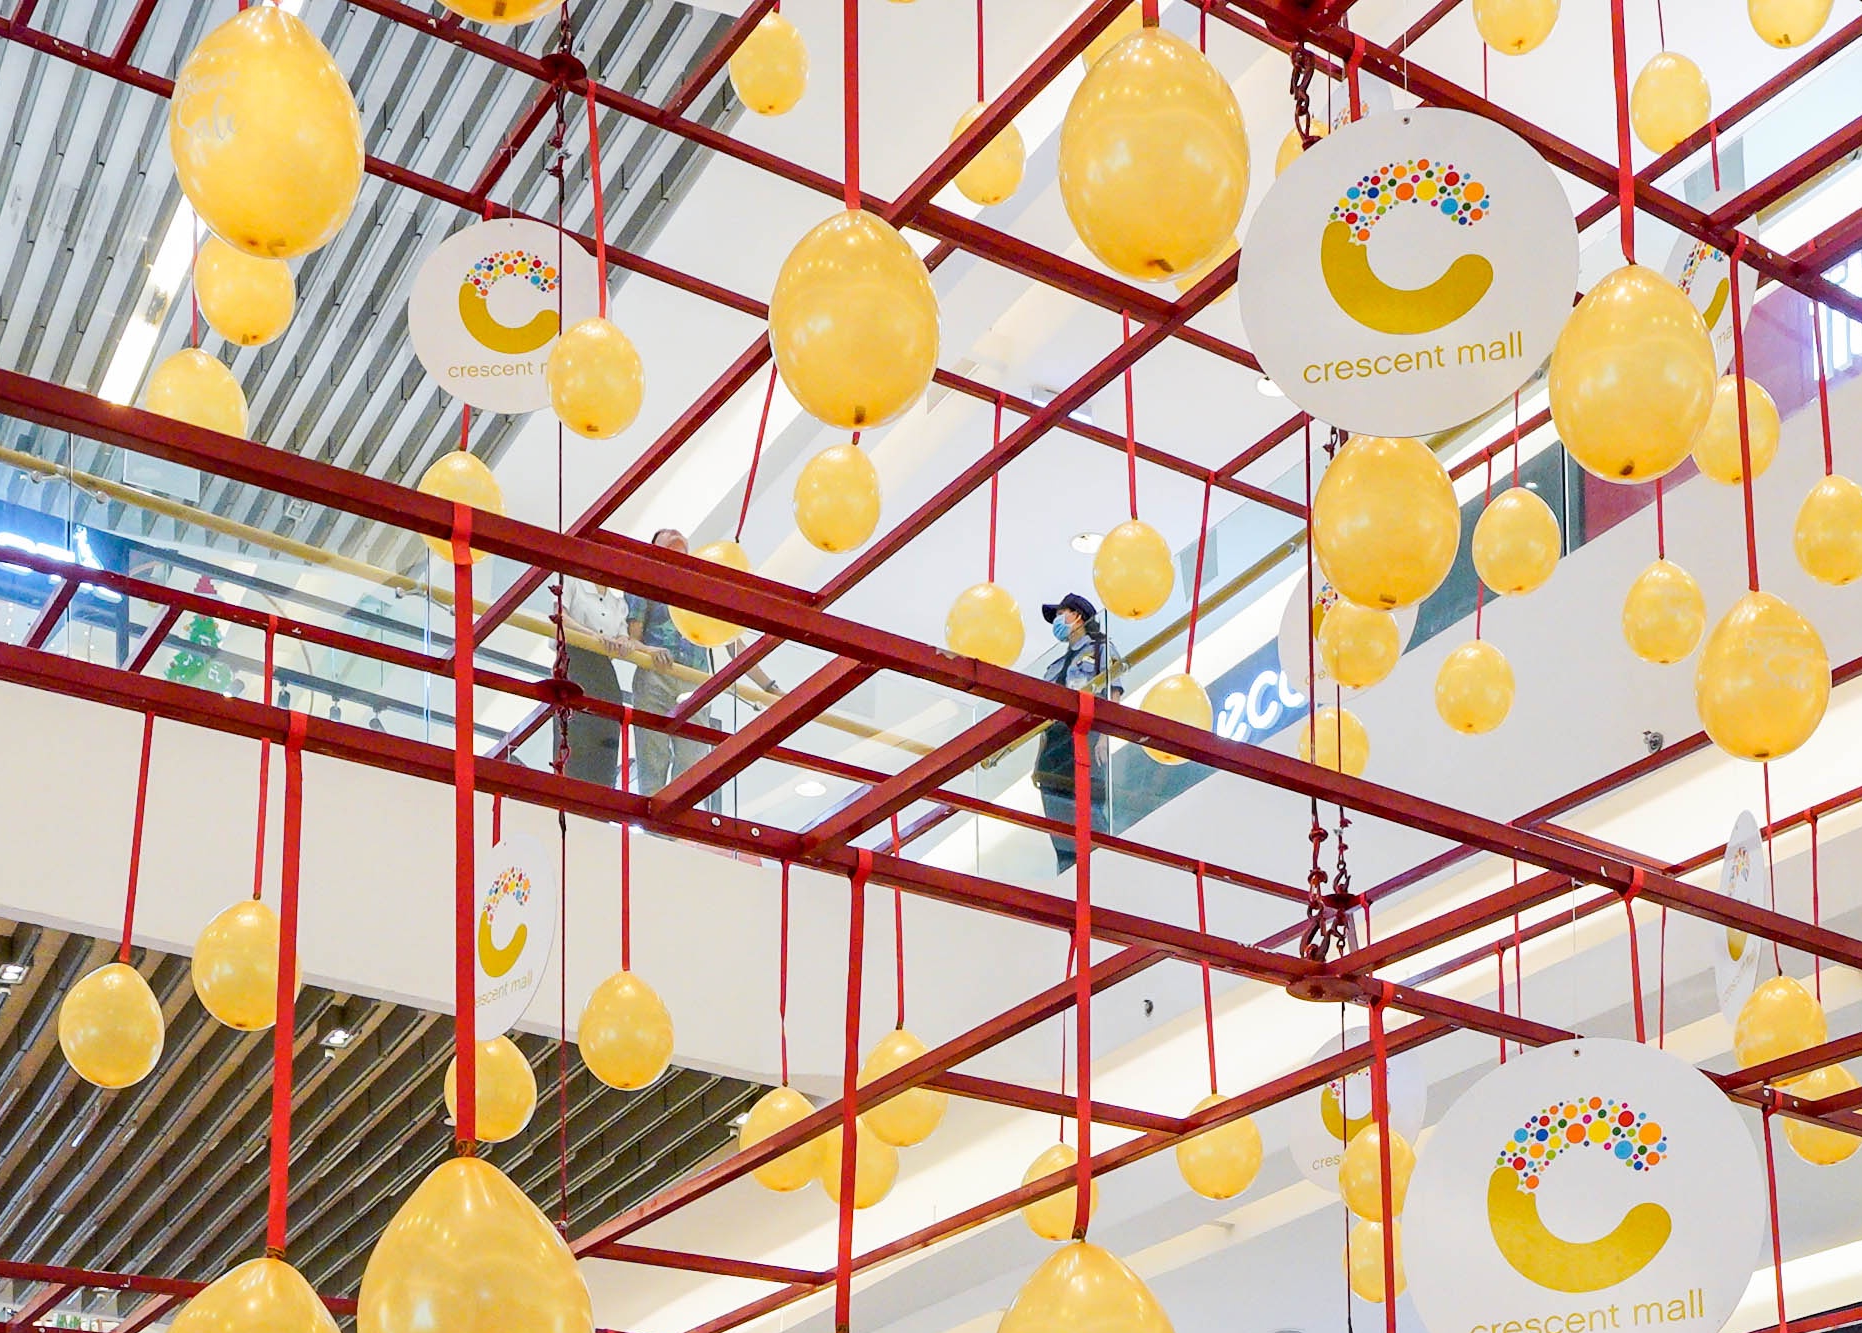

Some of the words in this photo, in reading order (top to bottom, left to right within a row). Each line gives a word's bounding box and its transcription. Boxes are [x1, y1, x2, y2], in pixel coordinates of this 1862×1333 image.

[448, 361, 533, 378] crescent
[1303, 345, 1445, 384] crescent
[1458, 331, 1523, 365] mall
[1312, 1154, 1340, 1171] cres
[1635, 1288, 1705, 1326] mall
